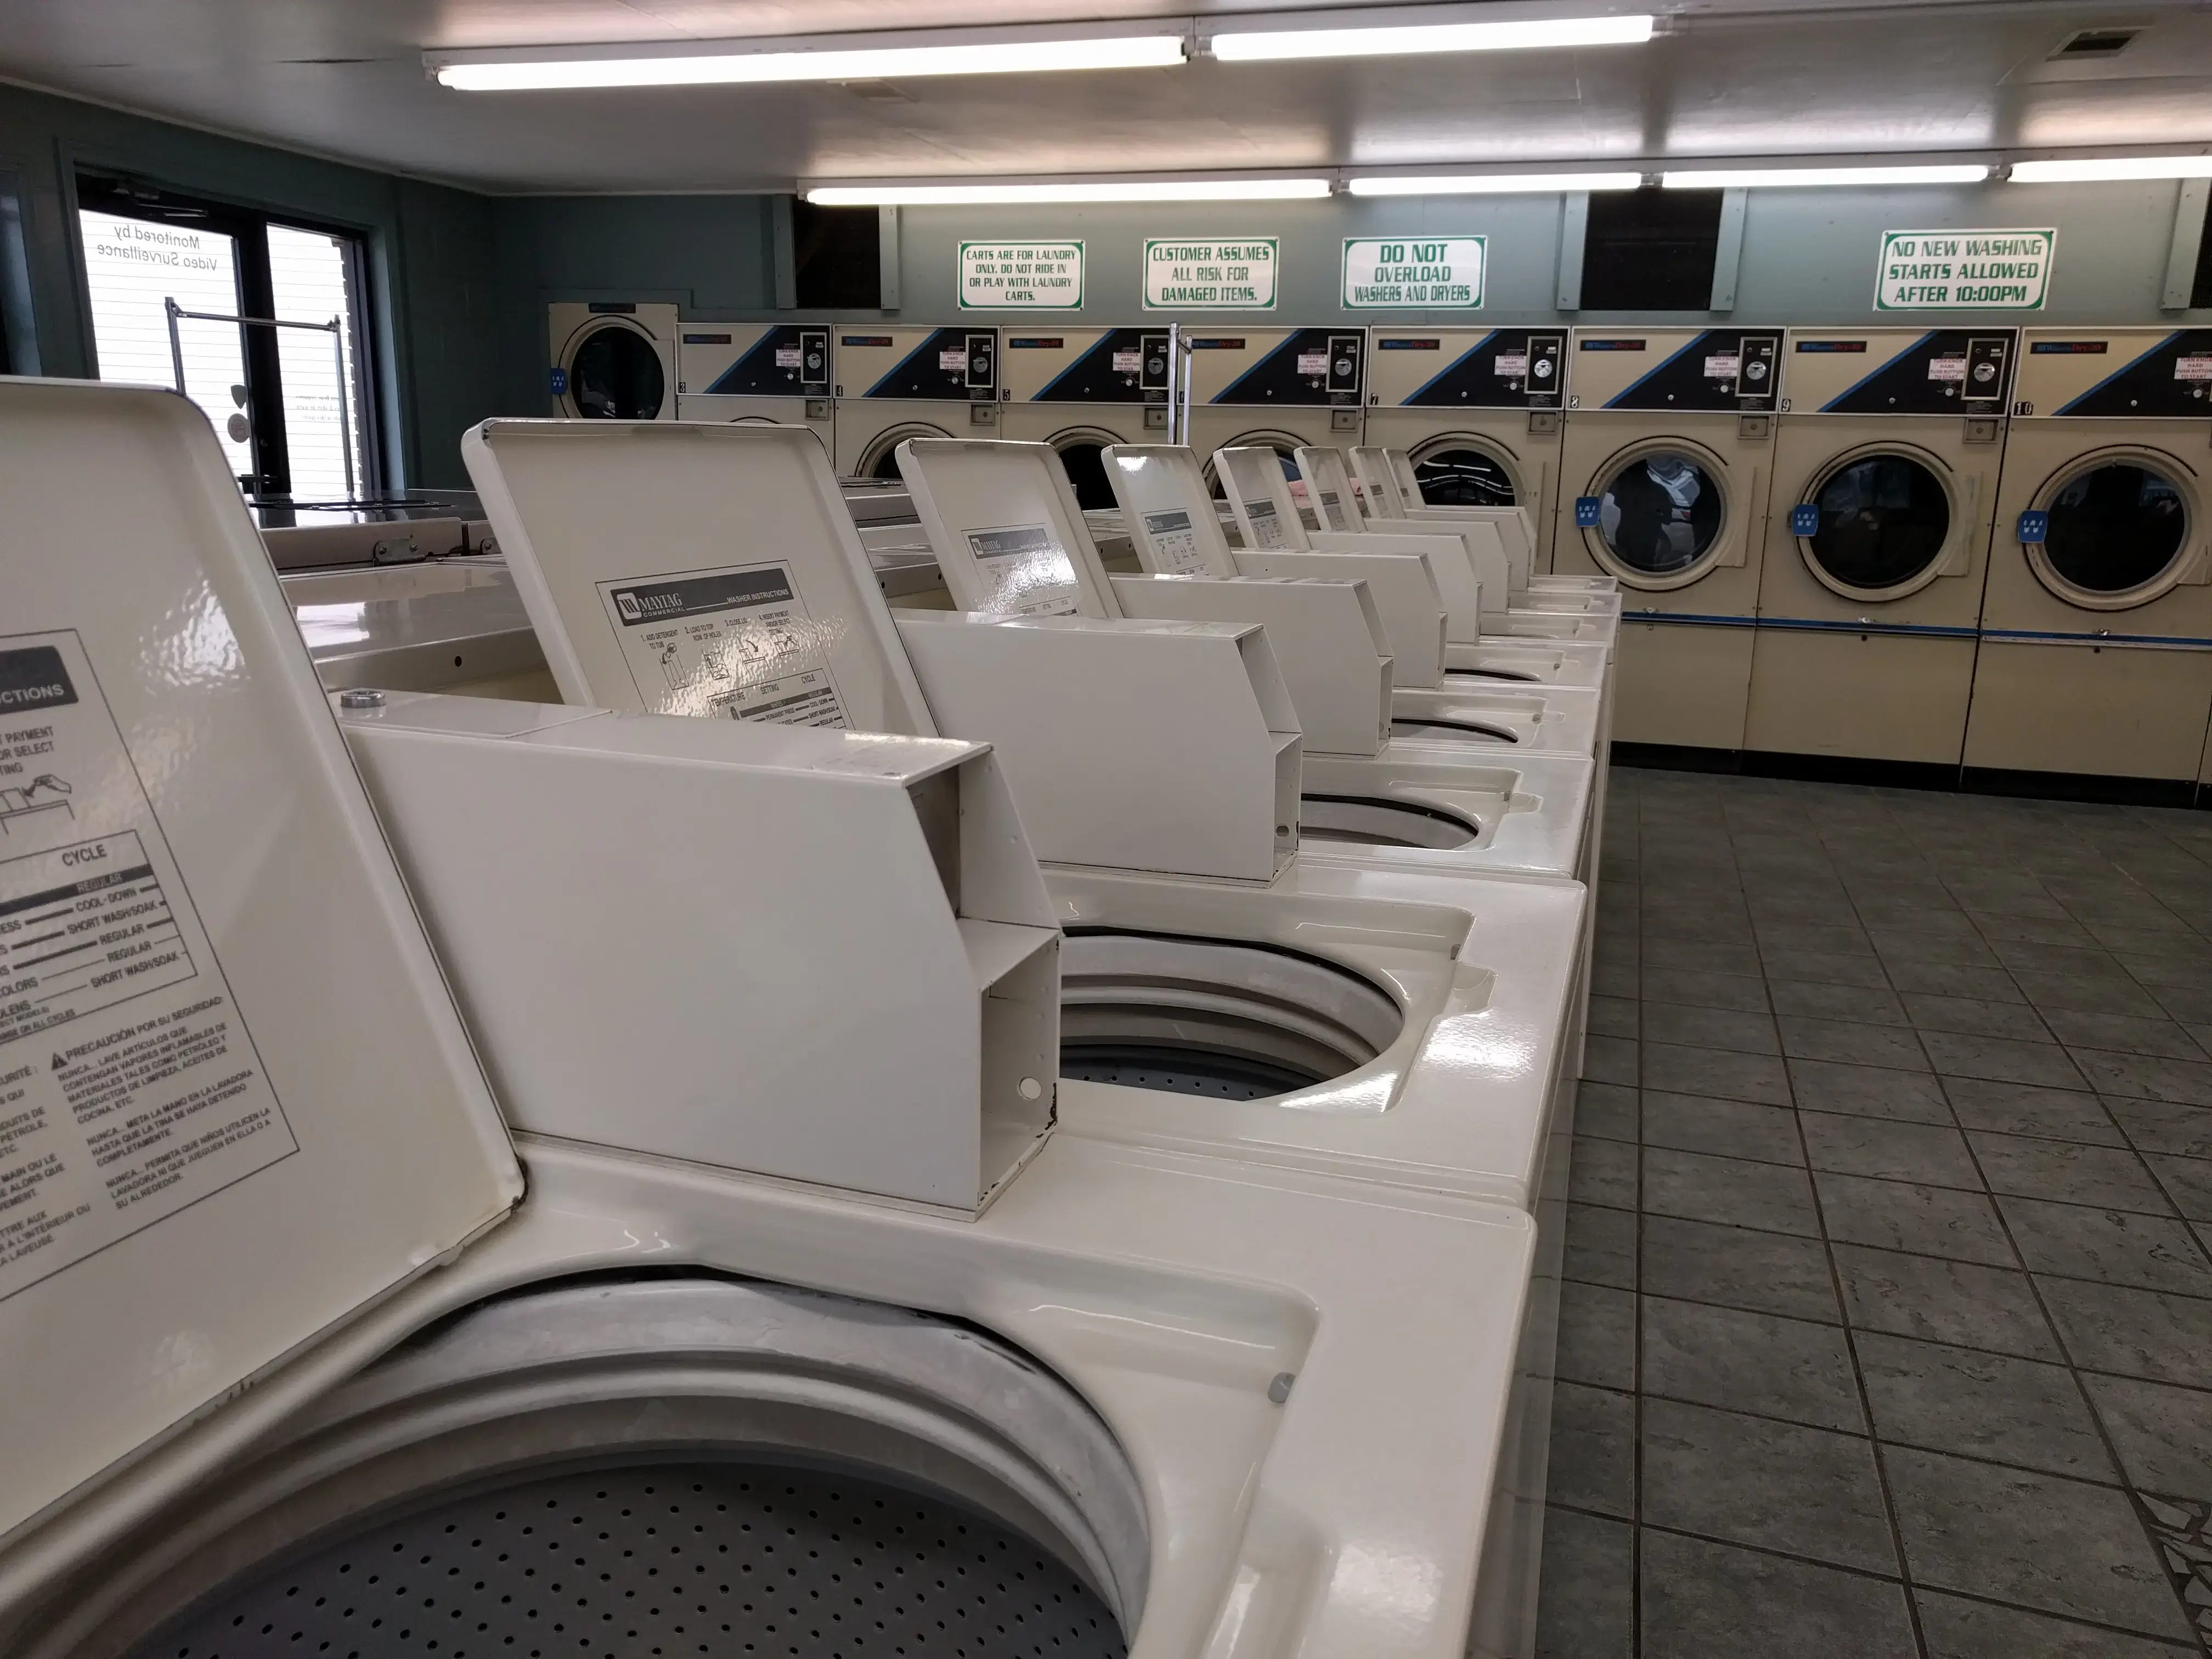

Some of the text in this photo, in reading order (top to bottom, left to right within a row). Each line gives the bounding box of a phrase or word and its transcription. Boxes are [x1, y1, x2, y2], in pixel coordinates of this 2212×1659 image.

[966, 250, 1076, 259] CARTS ARE FOR LAUNDRY
[1153, 246, 1269, 261] CUSTOMER ASSUMES
[1380, 244, 1448, 263] DO NOT
[1892, 239, 2042, 257] NO NEW WASHING
[1001, 264, 1012, 273] DO
[1015, 264, 1032, 273] NOT
[1035, 264, 1054, 273] RIDE
[1058, 264, 1066, 273] IN
[1171, 267, 1249, 281] ALL RISK FOR
[1374, 266, 1451, 283] OVERLOAD
[1888, 263, 2039, 279] STARTS ALLOWED
[969, 278, 1071, 287] OR PLAY WITH LAUNDRY
[1005, 291, 1035, 301] CARTS.
[1161, 287, 1257, 301] DAMAGED ITEMS.
[1355, 285, 1470, 302] WASHERS AND DRYERS
[1894, 286, 2027, 302] AFTER 10:00PM
[680, 382, 685, 393] 3
[837, 386, 842, 396] 4
[1005, 390, 1009, 400] 5
[1571, 396, 1578, 408] 8
[1782, 399, 1790, 411] 9
[2017, 402, 2032, 415] 10
[638, 592, 684, 613] MAYTAG
[727, 588, 789, 604] WASHER INSTRUCTIONS
[643, 607, 685, 617] COMMERCIAL
[656, 629, 679, 639] DETERGENT
[709, 630, 722, 639] HOLES
[800, 674, 816, 684] CYCLE
[760, 683, 780, 695] SETTING
[710, 692, 746, 708] TEMPERATURE
[5, 725, 54, 744] PAYMENT
[14, 741, 54, 757] SELECT
[61, 844, 108, 867] CYCLE
[76, 887, 137, 912] COOL-DOWN
[67, 916, 101, 934] SHORT
[99, 924, 145, 945] REGULAR
[106, 940, 152, 963] REGULAR
[89, 968, 124, 989] SHORT
[65, 1027, 136, 1060] PRECAUCIÓN
[137, 1020, 157, 1034] POR
[157, 1014, 171, 1025] SU
[98, 1051, 121, 1066] LAVE
[170, 1026, 188, 1038] QUE
[63, 1065, 119, 1092] CONTENGAN
[119, 1049, 159, 1070] VAPORES
[160, 1027, 215, 1054] INFLAMABLES
[215, 1022, 228, 1032] DE
[67, 1075, 123, 1103] MATERIALES
[124, 1064, 151, 1080] TALES
[151, 1054, 177, 1069] COMO
[72, 1086, 127, 1114] PRODUCTOS
[127, 1080, 141, 1091] DE
[182, 1050, 216, 1070] ACEITES
[216, 1045, 228, 1056] DE
[7, 1088, 25, 1102] QUI
[114, 1096, 135, 1109] ETC.
[125, 1113, 151, 1128] META
[150, 1108, 162, 1119] LA
[162, 1097, 188, 1113] MANO
[188, 1092, 200, 1102] EN
[200, 1087, 212, 1097] LA
[212, 1069, 253, 1092] LAVADORA
[31, 1105, 46, 1118] DE
[91, 1083, 247, 1157] HASTA QUE LA TINA SE HAYA DETENIDO
[144, 1149, 182, 1171] PERMITA
[181, 1139, 200, 1153] QUE
[224, 1112, 259, 1133] UTILICEN
[259, 1107, 271, 1118] LA
[96, 1128, 173, 1167] COMPLETAMENTE.
[44, 1153, 58, 1165] LE
[111, 1172, 158, 1199] LAVADORA
[167, 1158, 187, 1171] QUE
[188, 1141, 225, 1164] JUEGUEN
[224, 1134, 236, 1146] EN
[236, 1125, 257, 1139] ELLA
[256, 1121, 264, 1130] O
[44, 1162, 65, 1177] QUE
[115, 1172, 185, 1210] SU ALREDEDOR.
